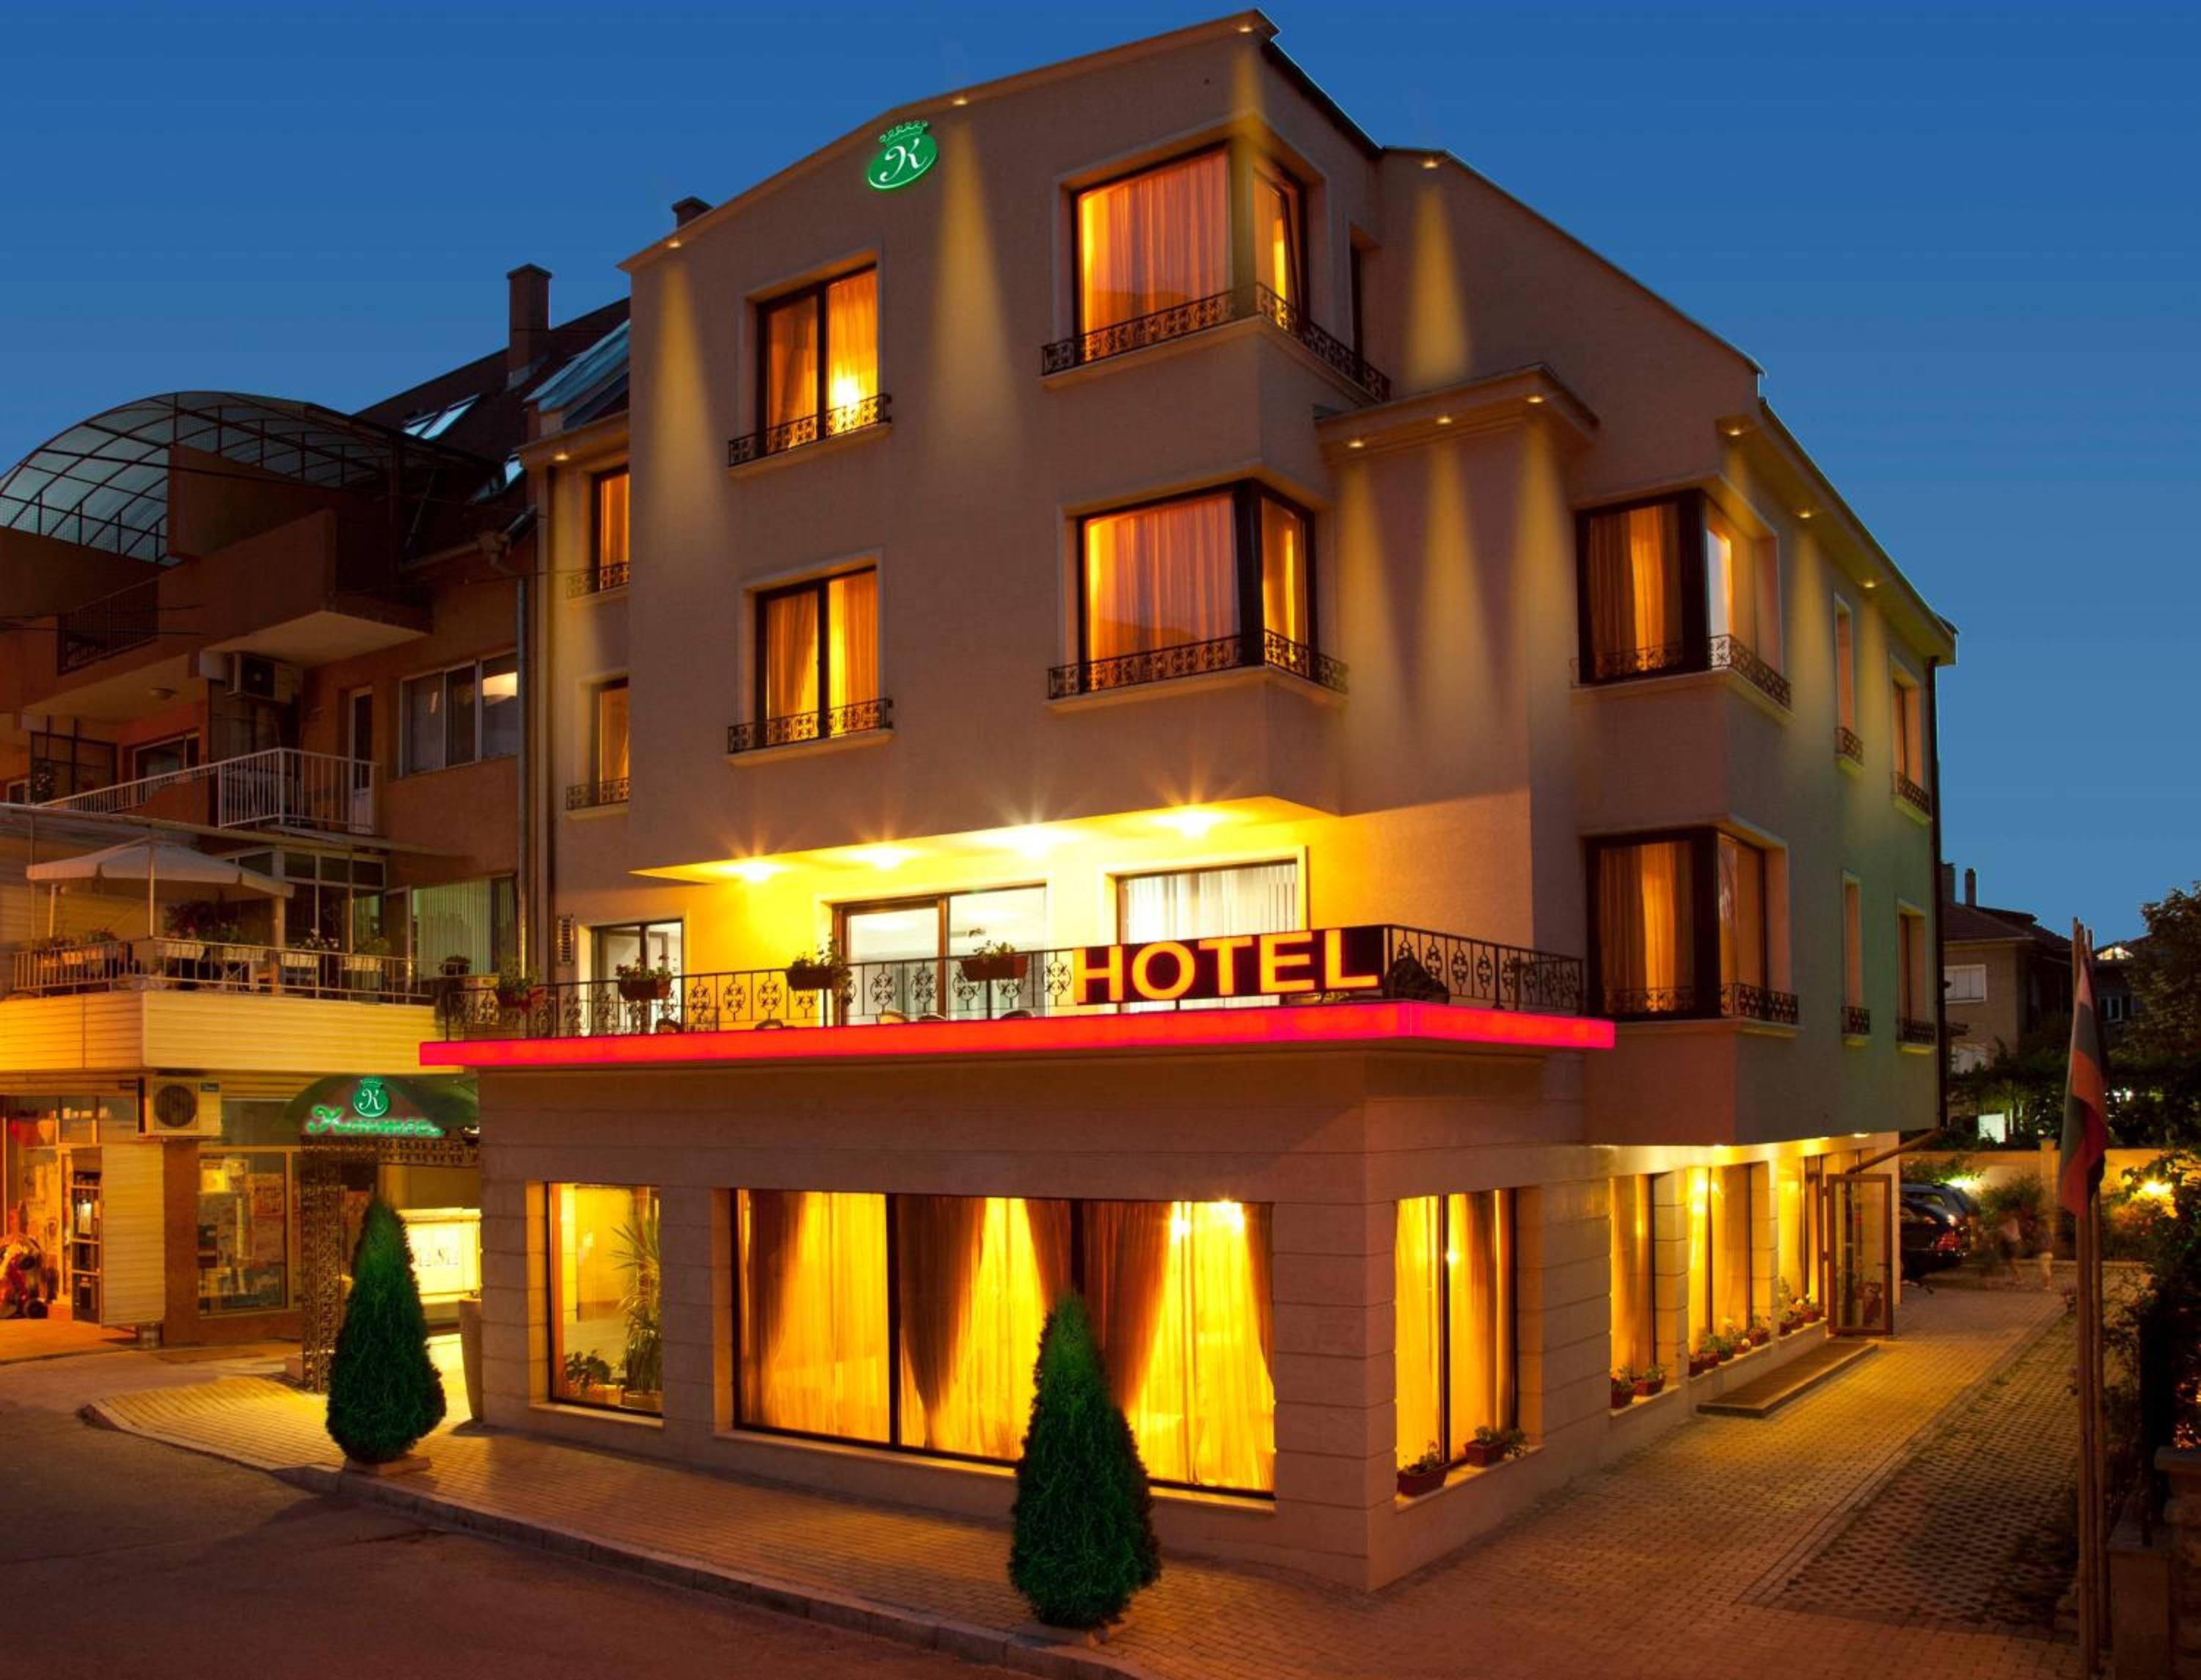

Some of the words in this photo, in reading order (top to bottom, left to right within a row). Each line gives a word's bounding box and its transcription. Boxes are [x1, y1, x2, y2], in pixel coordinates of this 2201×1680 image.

[879, 137, 927, 183] K
[1072, 928, 1379, 1004] HOTEL
[359, 1088, 384, 1110] K
